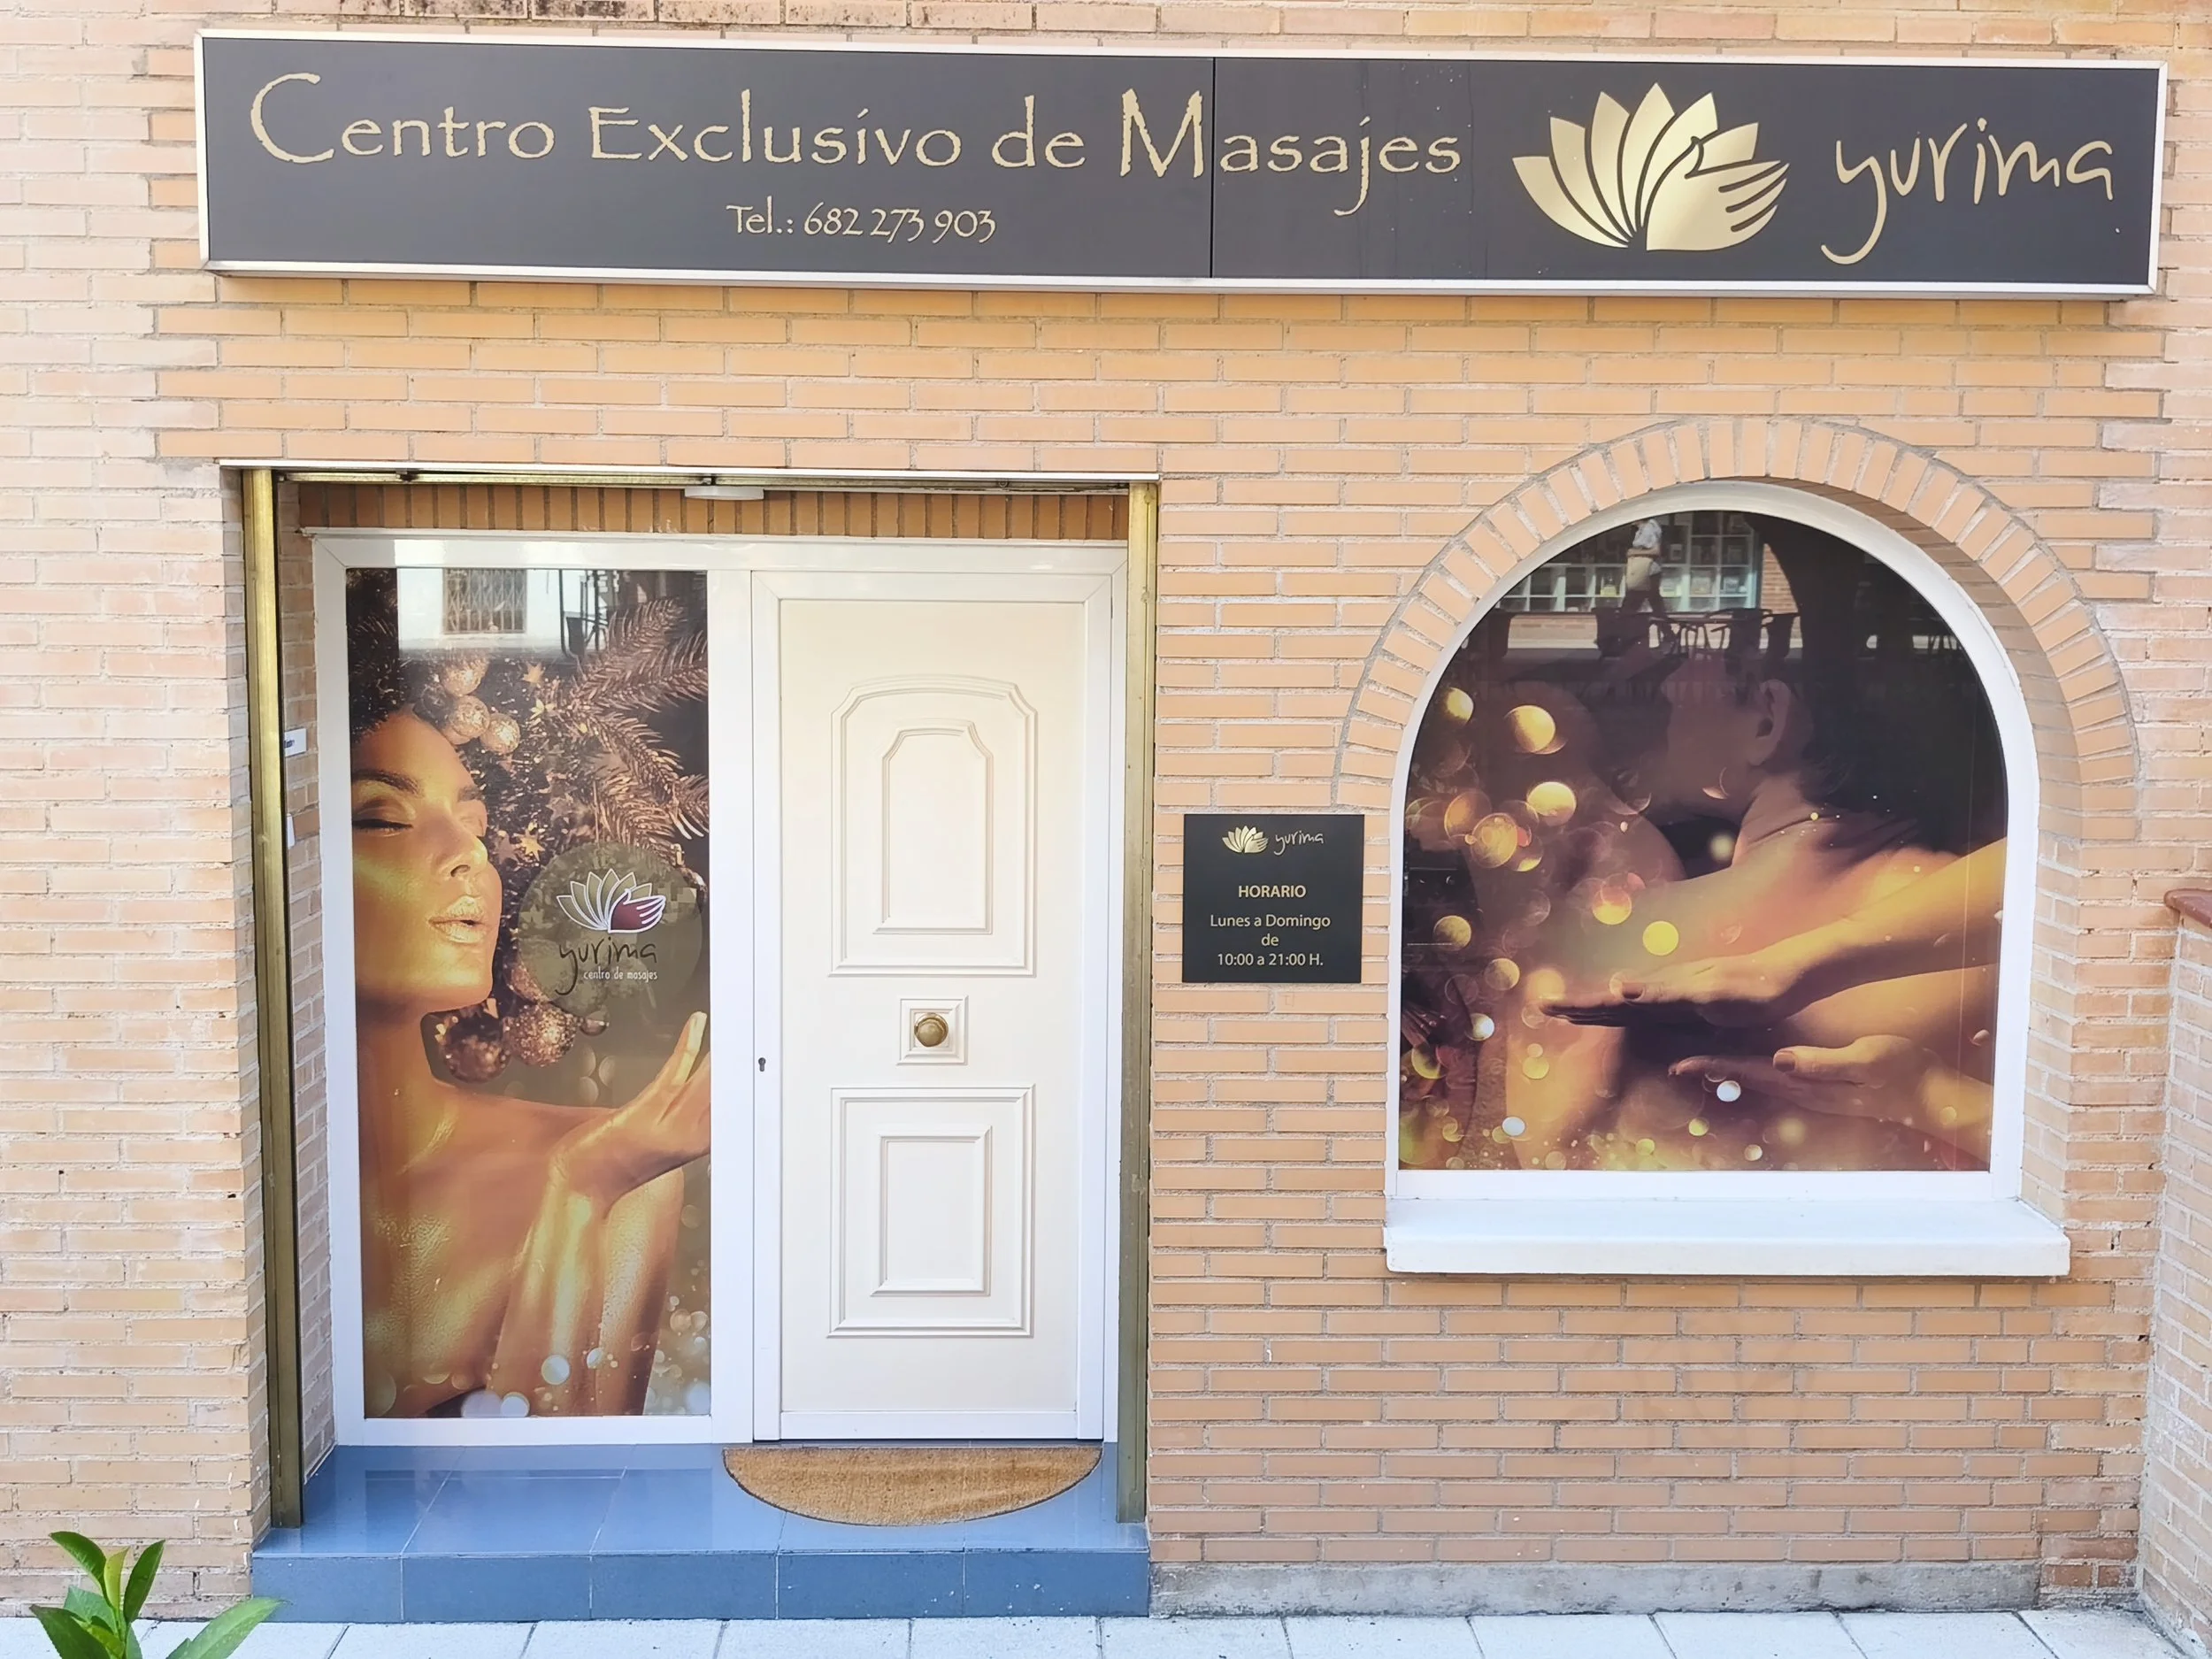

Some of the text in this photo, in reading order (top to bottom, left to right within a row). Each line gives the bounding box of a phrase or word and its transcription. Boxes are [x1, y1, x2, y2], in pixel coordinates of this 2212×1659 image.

[250, 71, 1462, 217] Centro Exclusivo de Masajes
[1820, 117, 2116, 265] yurima
[726, 196, 997, 244] Tel.: 682 273 903
[1273, 830, 1325, 856] yurima
[1238, 885, 1307, 898] HORARIO
[1210, 914, 1331, 930] Lunes a Domingo
[1261, 933, 1279, 947] de
[554, 936, 657, 995] yurima
[1217, 953, 1324, 966] 10:00 a 21:00 H.
[583, 965, 611, 980] centro
[613, 966, 624, 980] de
